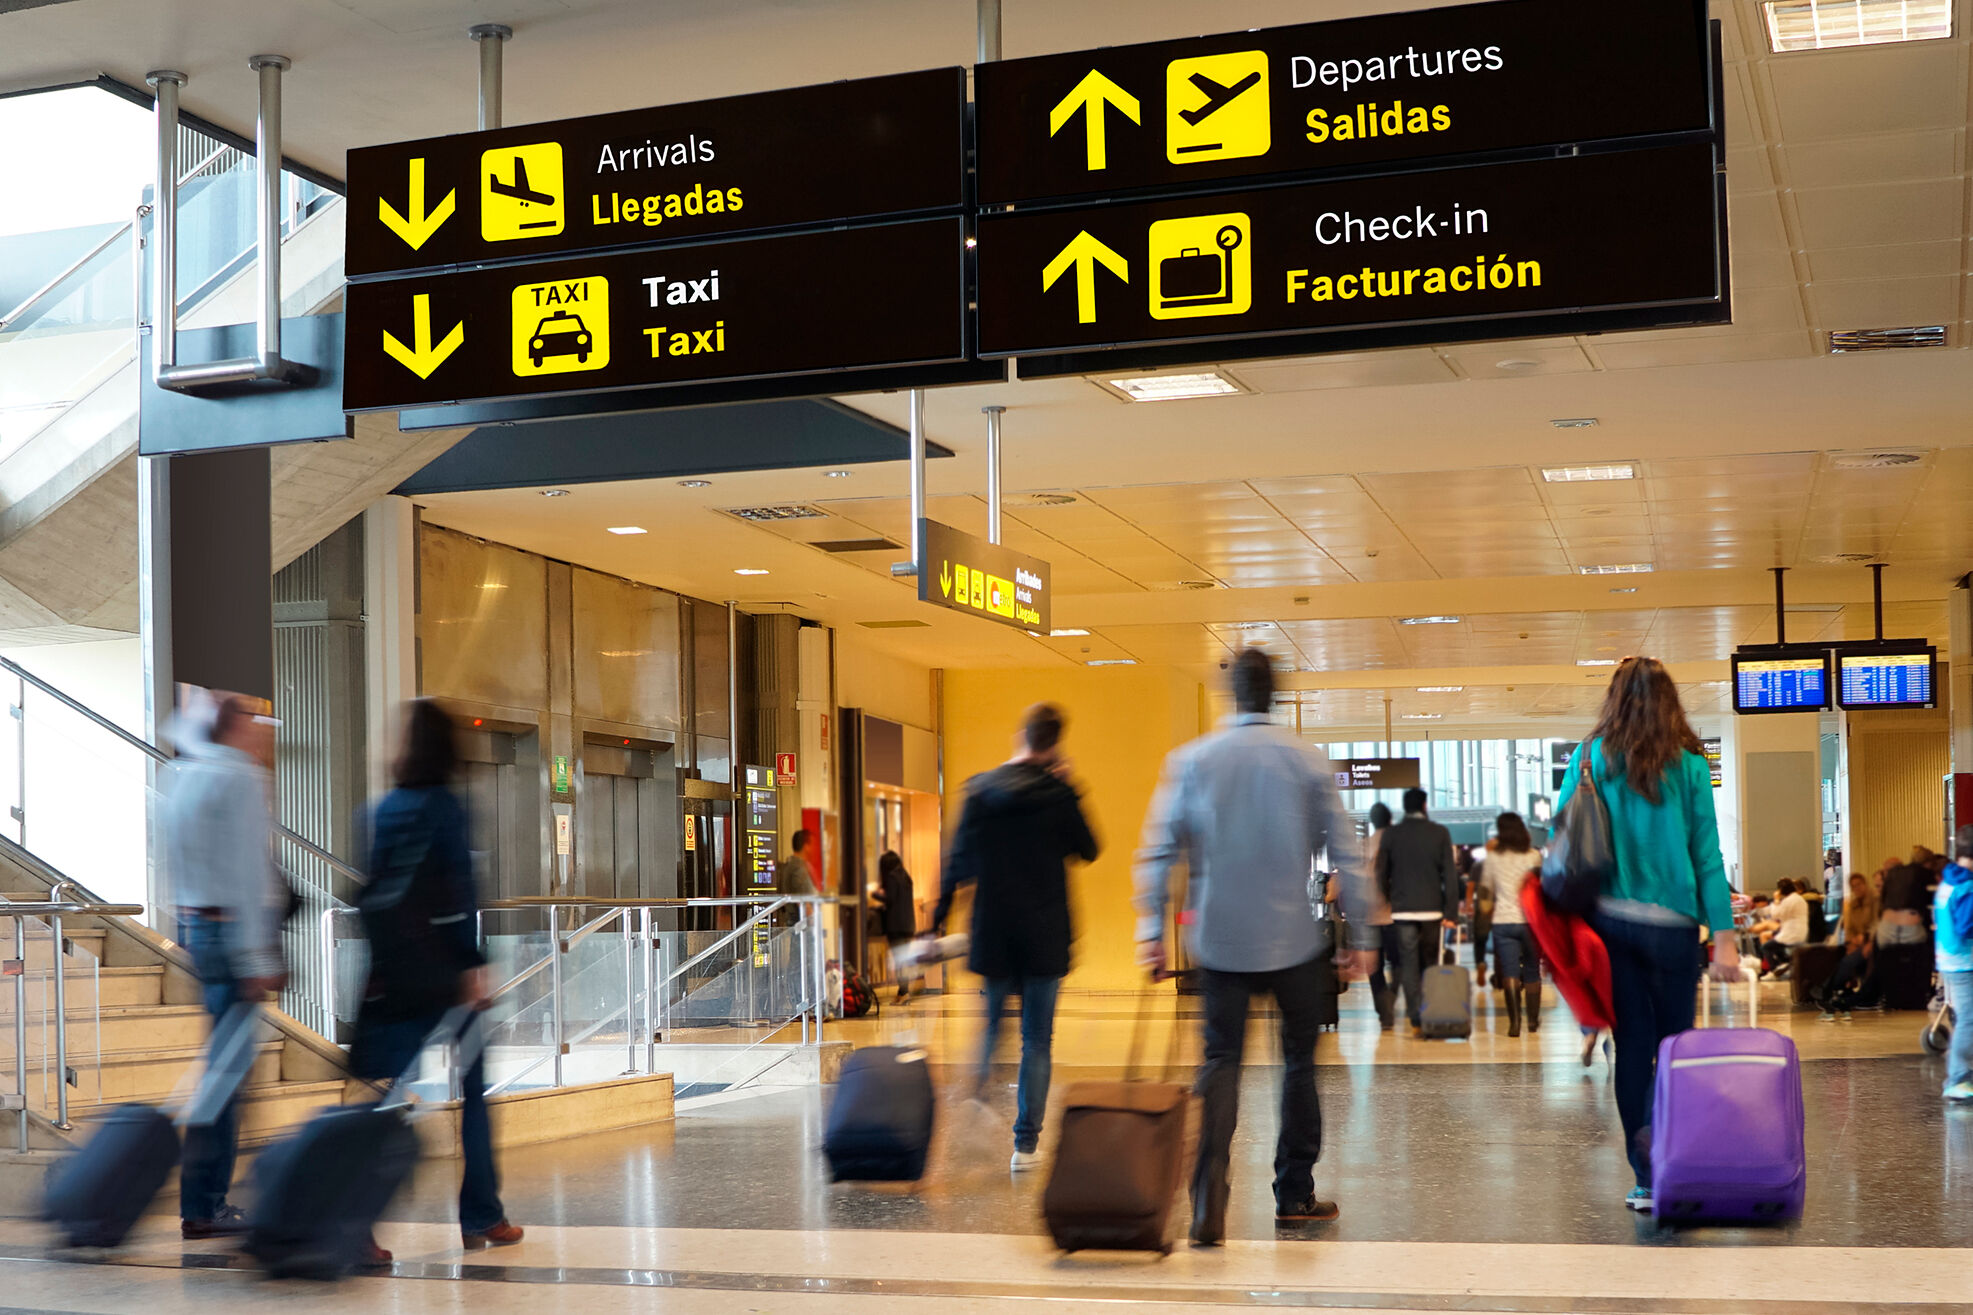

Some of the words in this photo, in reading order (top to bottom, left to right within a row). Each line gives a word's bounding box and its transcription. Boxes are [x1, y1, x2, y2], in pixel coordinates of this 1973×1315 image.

[1291, 45, 1504, 91] Departures
[1305, 100, 1451, 144] Salidas
[597, 134, 715, 174] Arrivals
[592, 183, 744, 227] Llegadas
[1315, 202, 1489, 245] Check-in
[531, 281, 589, 306] TAXI
[642, 269, 720, 308] Taxi
[1286, 254, 1541, 303] Facturación
[643, 321, 725, 358] Taxi
